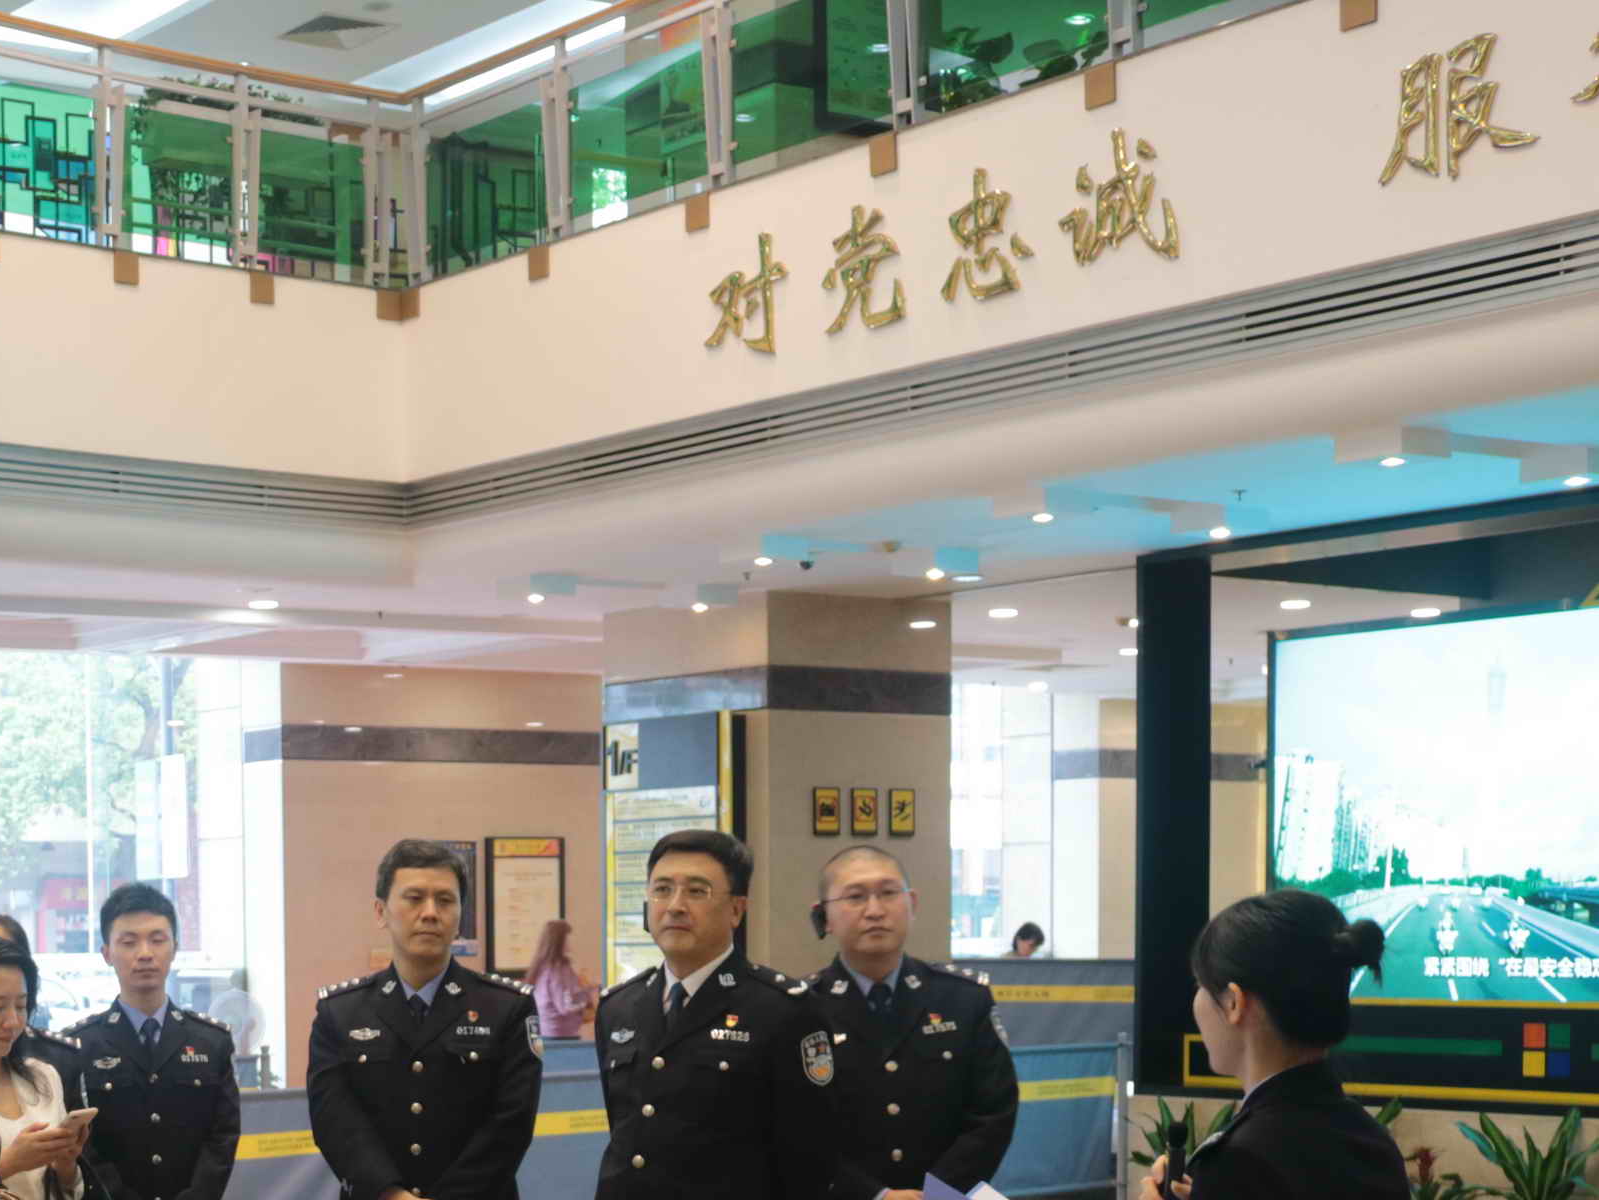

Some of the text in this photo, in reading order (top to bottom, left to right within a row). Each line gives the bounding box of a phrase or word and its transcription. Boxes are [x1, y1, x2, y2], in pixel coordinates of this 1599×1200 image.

[704, 31, 1599, 356] 对党忠诚 服
[1424, 956, 1490, 978] 紧紧围绕
